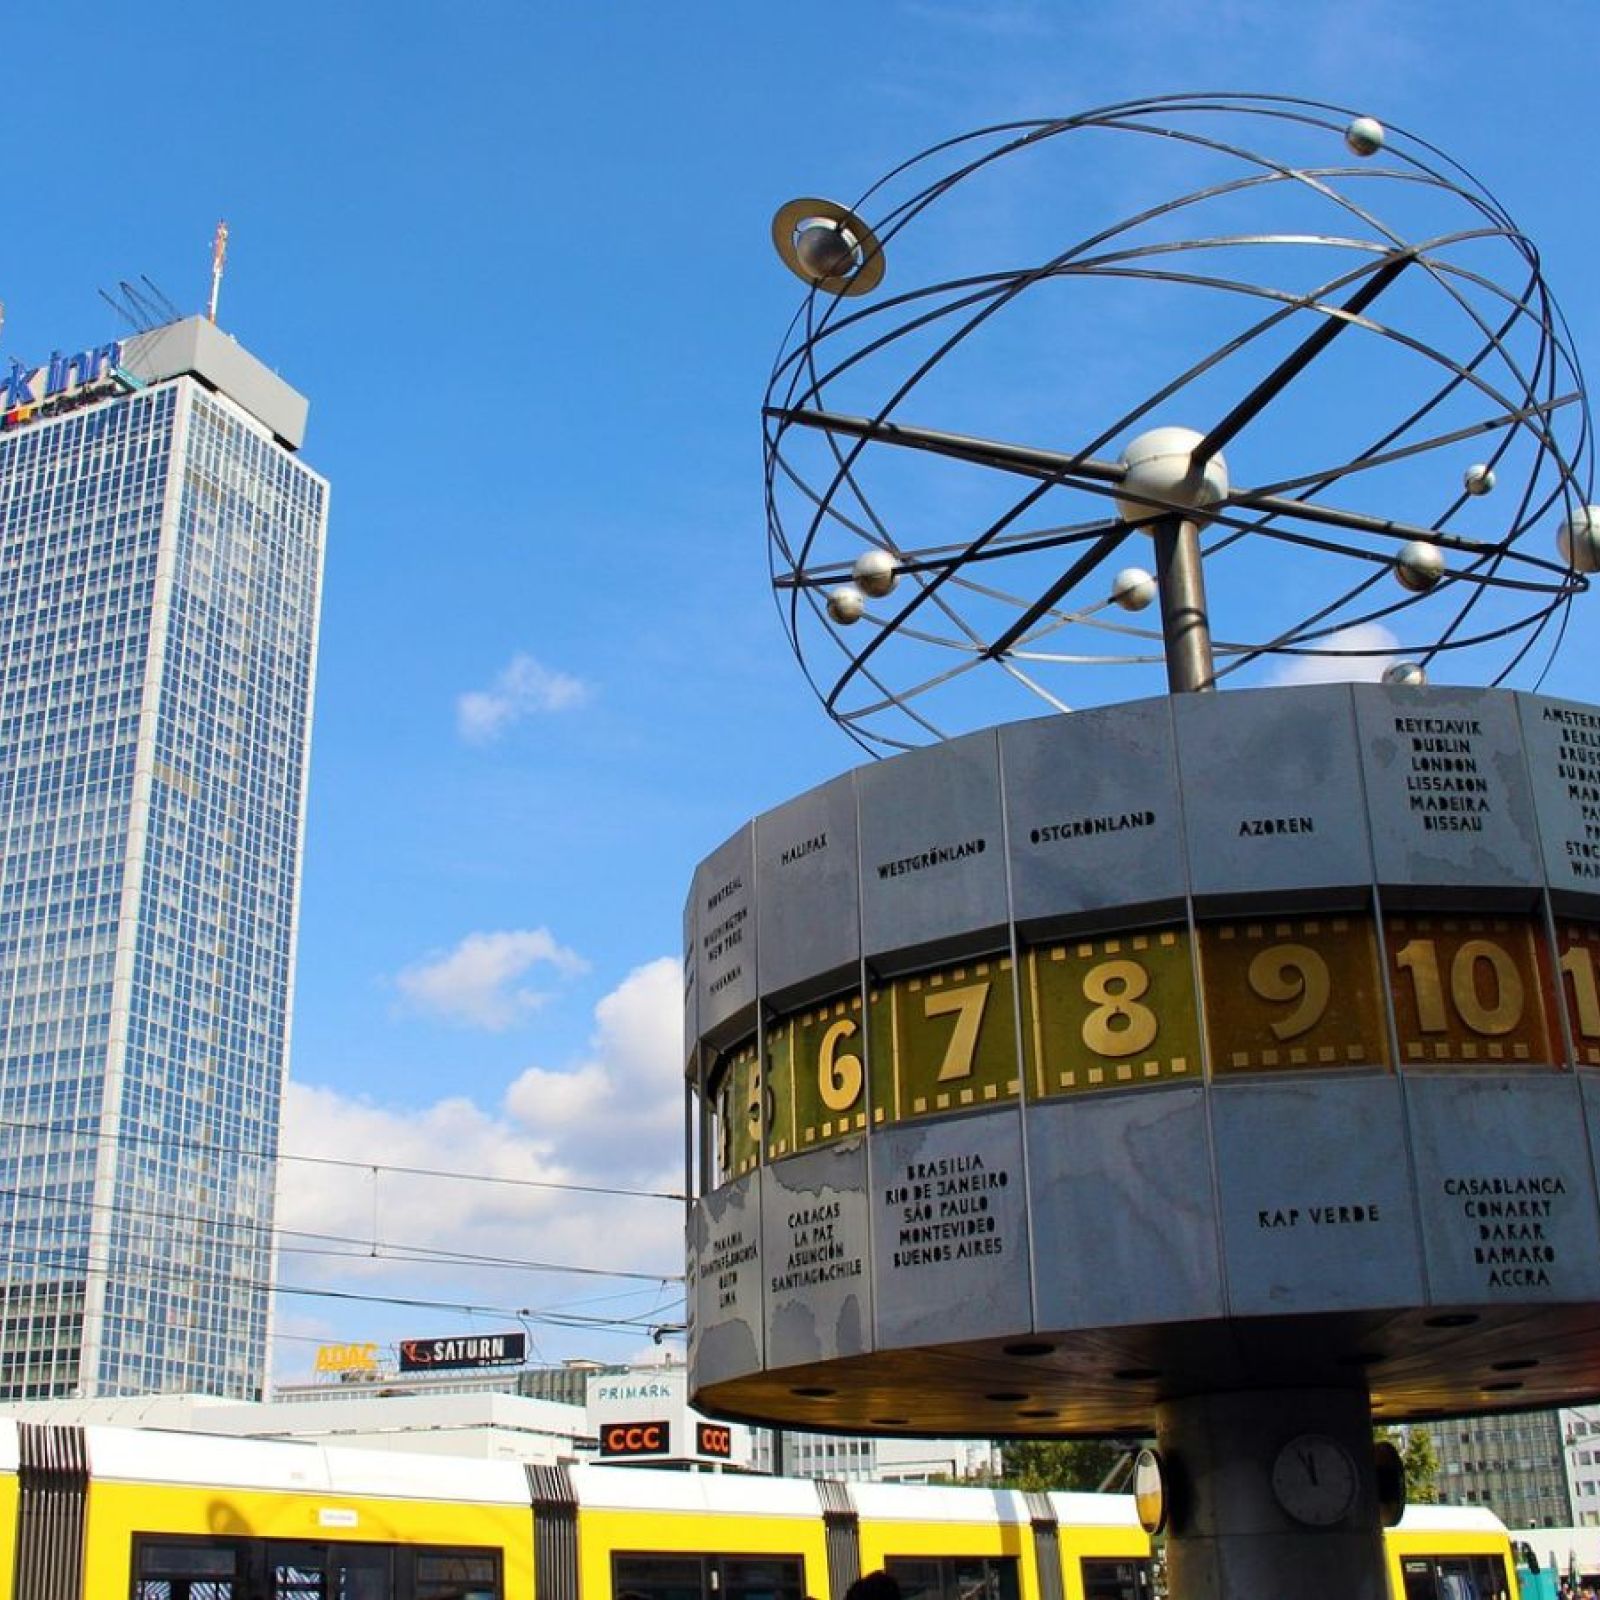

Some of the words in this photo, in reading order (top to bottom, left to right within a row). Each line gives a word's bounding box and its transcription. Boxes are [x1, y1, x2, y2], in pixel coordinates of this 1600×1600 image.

[48, 341, 122, 396] inn
[1395, 718, 1482, 736] REYKJAVIK
[1543, 706, 1600, 729] AMSTER
[1412, 738, 1470, 754] DUBLIN
[1412, 757, 1476, 773] LONDON
[1407, 776, 1487, 792] LISSABON
[1410, 796, 1491, 812] MADEIRA
[1239, 817, 1313, 837] AZOREN
[1423, 816, 1482, 832] BISSAU
[781, 833, 827, 865] HALIFAX
[877, 838, 986, 879] WESTGRÖNLAND
[1248, 943, 1331, 1041] 9
[1397, 939, 1524, 1036] 10
[1081, 960, 1157, 1057] 8
[925, 982, 990, 1082] 7
[818, 1018, 862, 1111] 6
[907, 1154, 984, 1181] BRASILIA
[886, 1187, 908, 1205] RIO
[914, 1183, 931, 1200] DE
[937, 1171, 1008, 1196] JANEIRO
[1444, 1178, 1566, 1196] CASABLANCA
[788, 1202, 840, 1229] CARACAS
[940, 1196, 988, 1217] PAULO
[1258, 1209, 1299, 1228] KAP
[1309, 1205, 1380, 1225] VERDE
[1465, 1200, 1551, 1218] CONAKRY
[795, 1231, 808, 1248] LA
[813, 1224, 834, 1243] PAZ
[900, 1216, 995, 1246] MONTEVIDEO
[1480, 1223, 1545, 1240] DAKAR
[894, 1245, 951, 1268] BUENOS
[957, 1237, 1002, 1259] AIRES
[1474, 1246, 1555, 1264] BAMAKO
[1489, 1269, 1550, 1287] ACCRA
[433, 1338, 505, 1361] SATURN
[599, 1385, 671, 1400] PRIMARK
[608, 1427, 660, 1450] CCC
[702, 1428, 729, 1453] CCC
